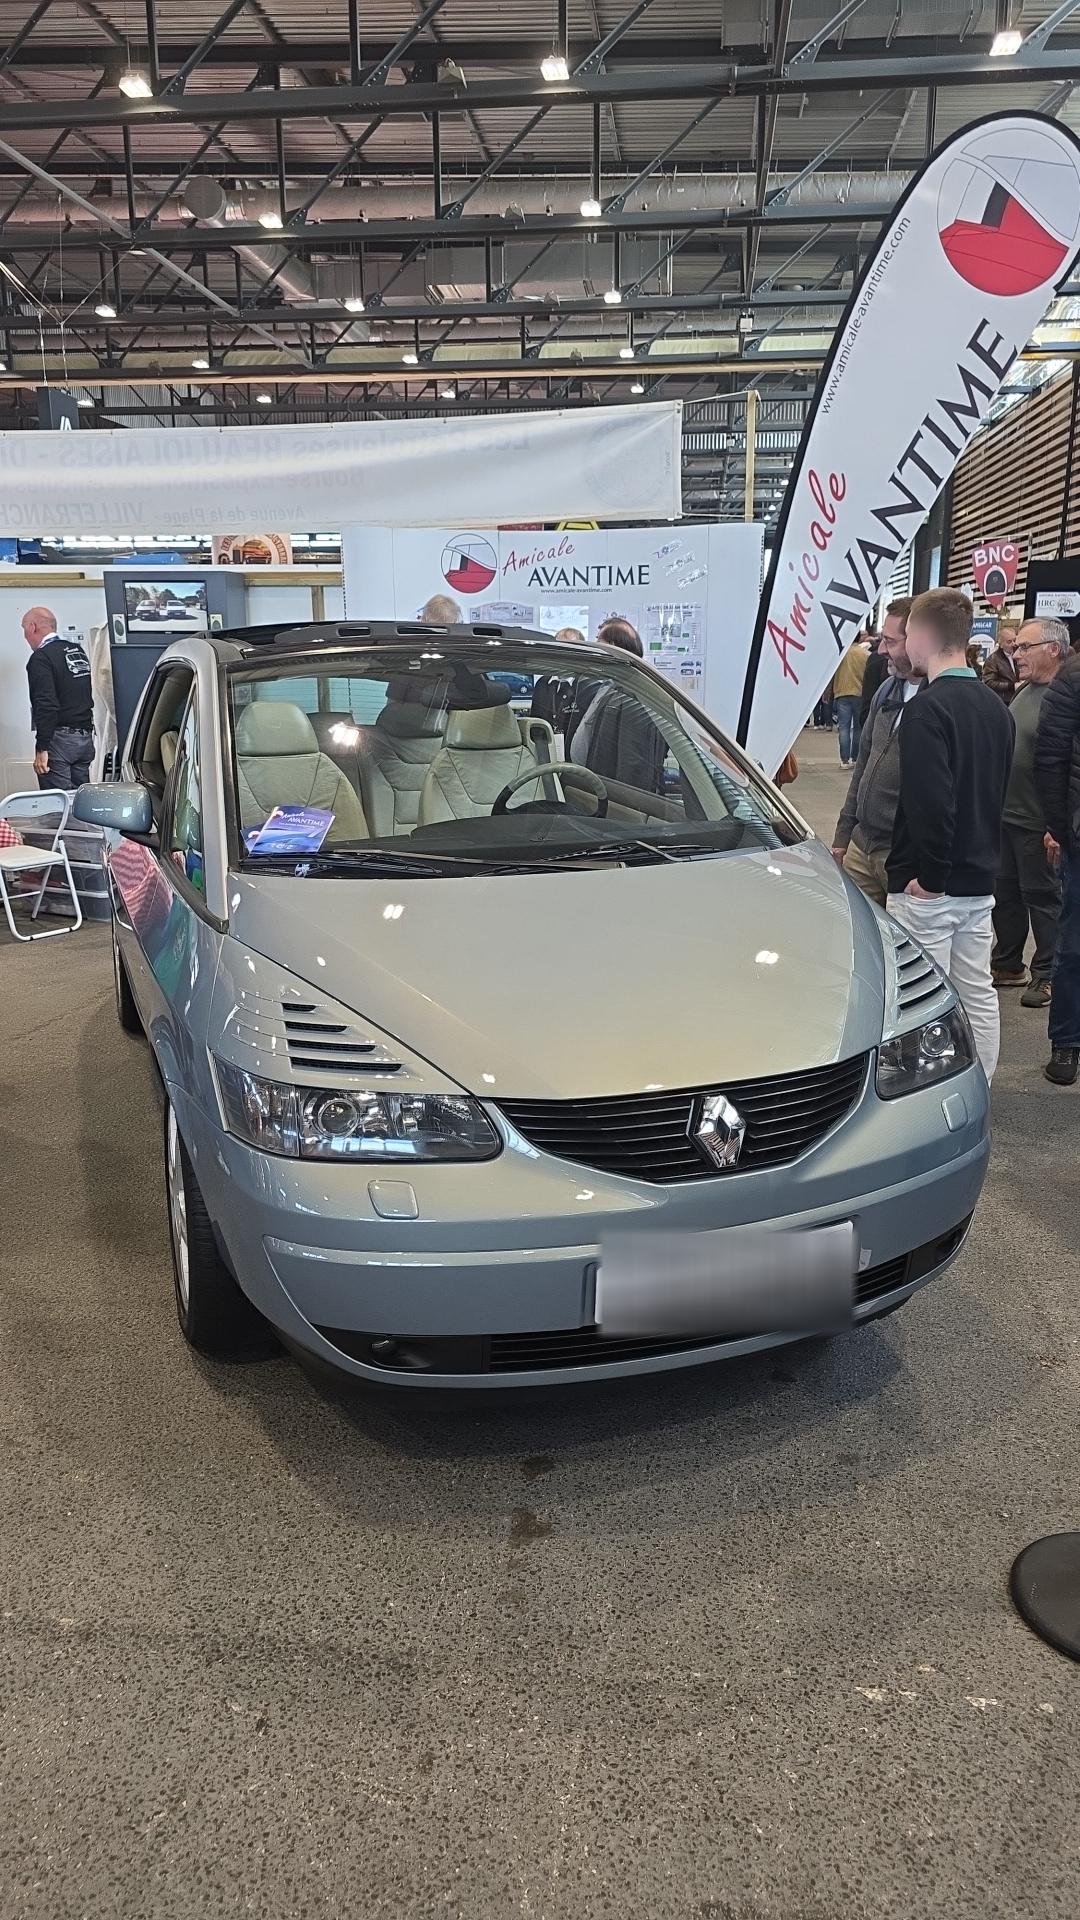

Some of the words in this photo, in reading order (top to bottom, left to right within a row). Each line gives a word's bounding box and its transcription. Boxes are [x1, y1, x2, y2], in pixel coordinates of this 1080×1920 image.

[821, 216, 911, 415] www.amicale-avantime.com
[820, 317, 1018, 655] AVANTIME
[502, 535, 575, 576] Amicale
[527, 564, 650, 587] AVANTIME
[974, 545, 1015, 567] BNC
[767, 469, 847, 685] Amicale
[288, 817, 324, 827] AVANTIME
